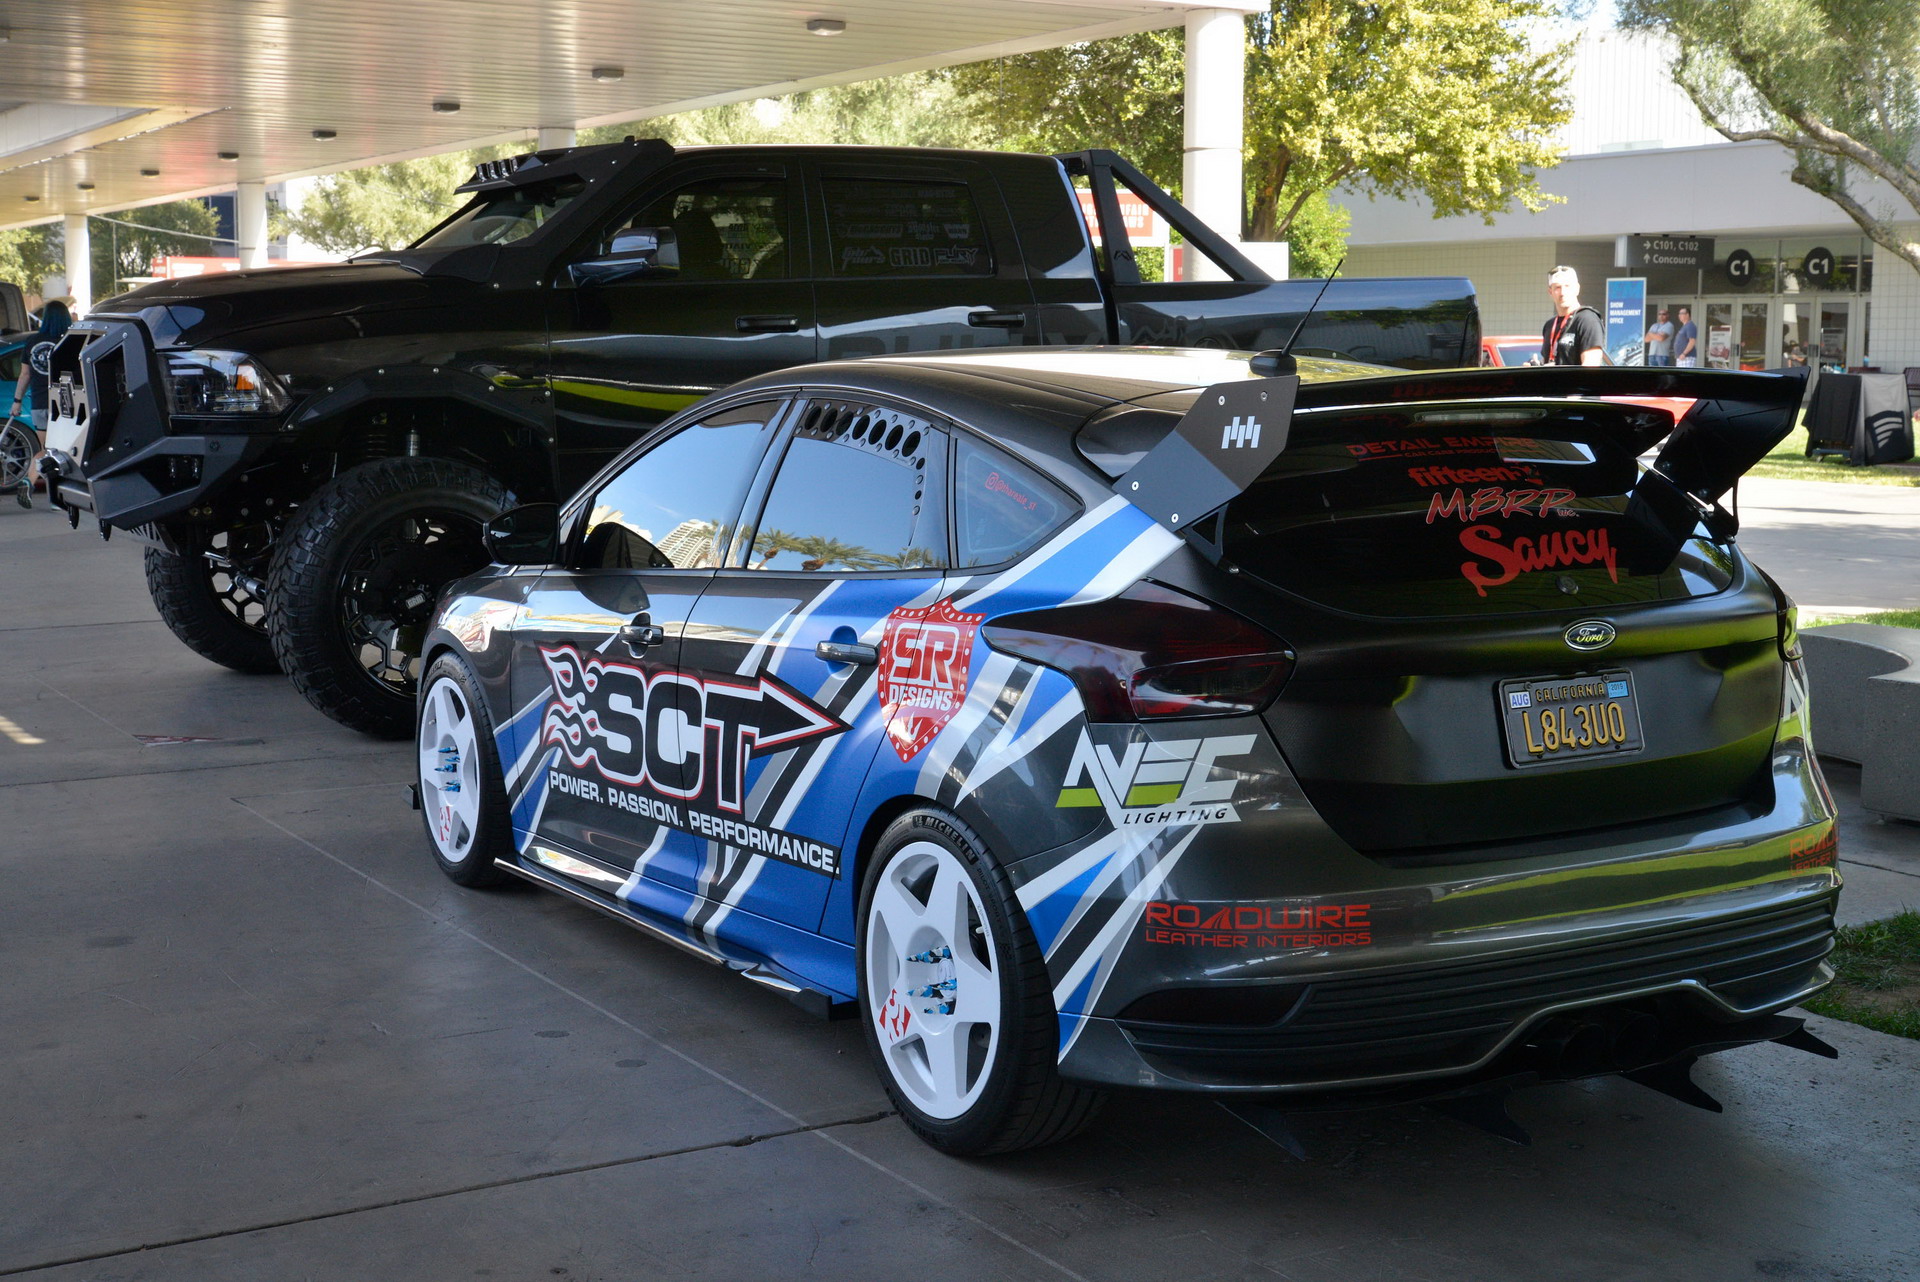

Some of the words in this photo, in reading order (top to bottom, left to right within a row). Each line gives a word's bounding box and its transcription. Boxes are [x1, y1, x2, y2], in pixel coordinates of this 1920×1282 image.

[889, 246, 932, 267] GRID
[1653, 240, 1675, 251] C101,
[1678, 241, 1699, 251] C102
[1652, 254, 1696, 265] Concourse
[1730, 260, 1749, 275] C1
[1808, 258, 1829, 274] C1
[1609, 301, 1624, 309] SHOW
[1346, 437, 1440, 456] DETAIL
[1425, 486, 1576, 524] MBRP
[1459, 524, 1618, 597] Saucy
[888, 622, 960, 690] SR
[888, 684, 954, 712] DESIGNS
[1511, 693, 1530, 707] AUG
[1536, 684, 1605, 701] CALIFORNIA
[575, 655, 810, 815] SCT
[550, 770, 604, 804] POWER.
[608, 789, 684, 827] PASSION.
[690, 812, 840, 875] PERFORMANCE.
[1123, 808, 1228, 825] LIGHTING
[925, 816, 978, 863] MICHELIN
[1146, 902, 1371, 930] ROADWIRE
[1146, 930, 1248, 948] LEATHER
[1257, 931, 1371, 948] INTERIORS
